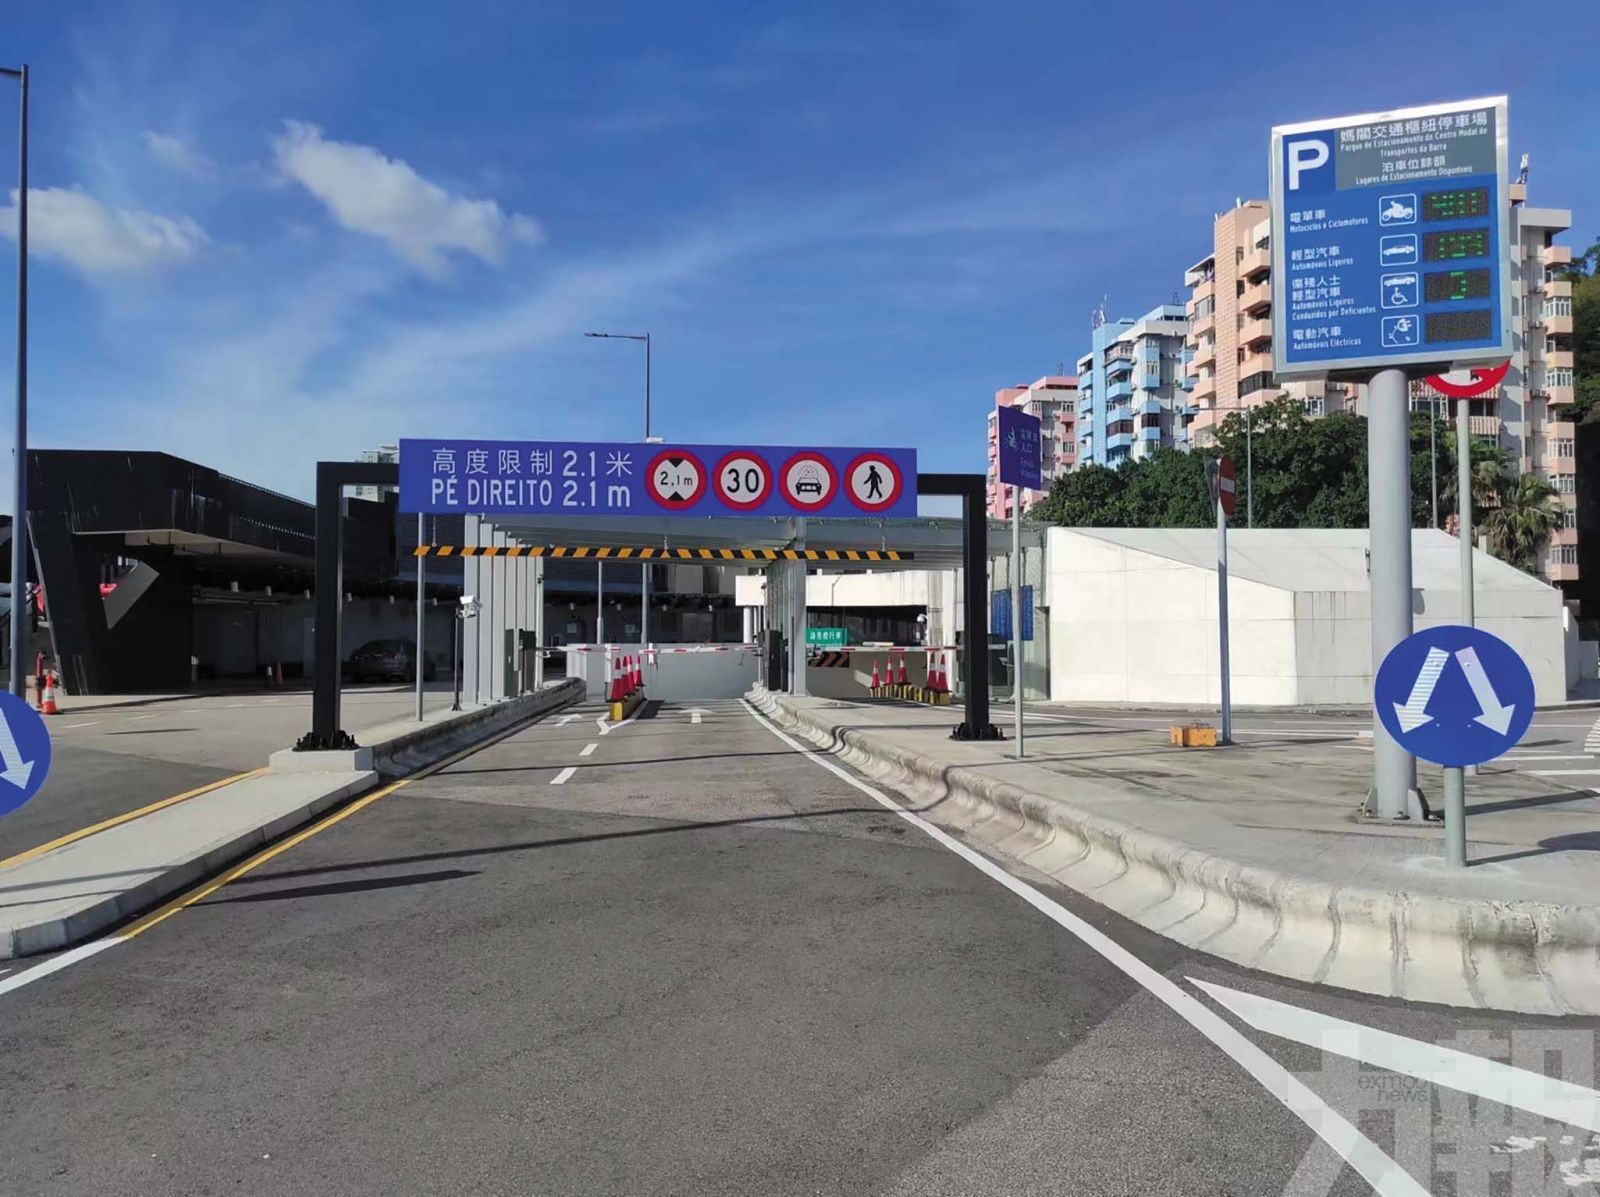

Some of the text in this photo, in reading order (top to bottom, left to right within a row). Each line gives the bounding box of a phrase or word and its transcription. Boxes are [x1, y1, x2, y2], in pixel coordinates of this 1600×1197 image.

[1340, 142, 1363, 153] Parque
[1364, 140, 1372, 149] de
[1373, 134, 1424, 148] Estacionamento
[1434, 130, 1457, 141] Centro
[1458, 128, 1478, 138] Modal
[1479, 127, 1488, 135] de
[1380, 142, 1447, 157] Transportes da Barra
[1288, 139, 1330, 191] P
[1355, 175, 1380, 186] Lugares
[1381, 173, 1389, 182] de
[1389, 168, 1438, 181] Estacionamento
[1289, 208, 1326, 223] 電單車
[1289, 222, 1322, 233] Motociclos
[1328, 216, 1369, 228] Ciclomotores
[1291, 245, 1340, 261] 輕型汽車
[1328, 257, 1354, 268] Ligeiros
[1291, 286, 1341, 302] 輕型汽車
[1329, 297, 1354, 309] Ligeiros
[1328, 309, 1339, 319] por
[1340, 305, 1376, 316] Deficientes
[1292, 325, 1342, 341] 電動汽車
[431, 447, 633, 478] 高度限制 2.1 米
[726, 468, 760, 493] 30
[431, 475, 631, 508] PÉ DIREITO 2.1 m
